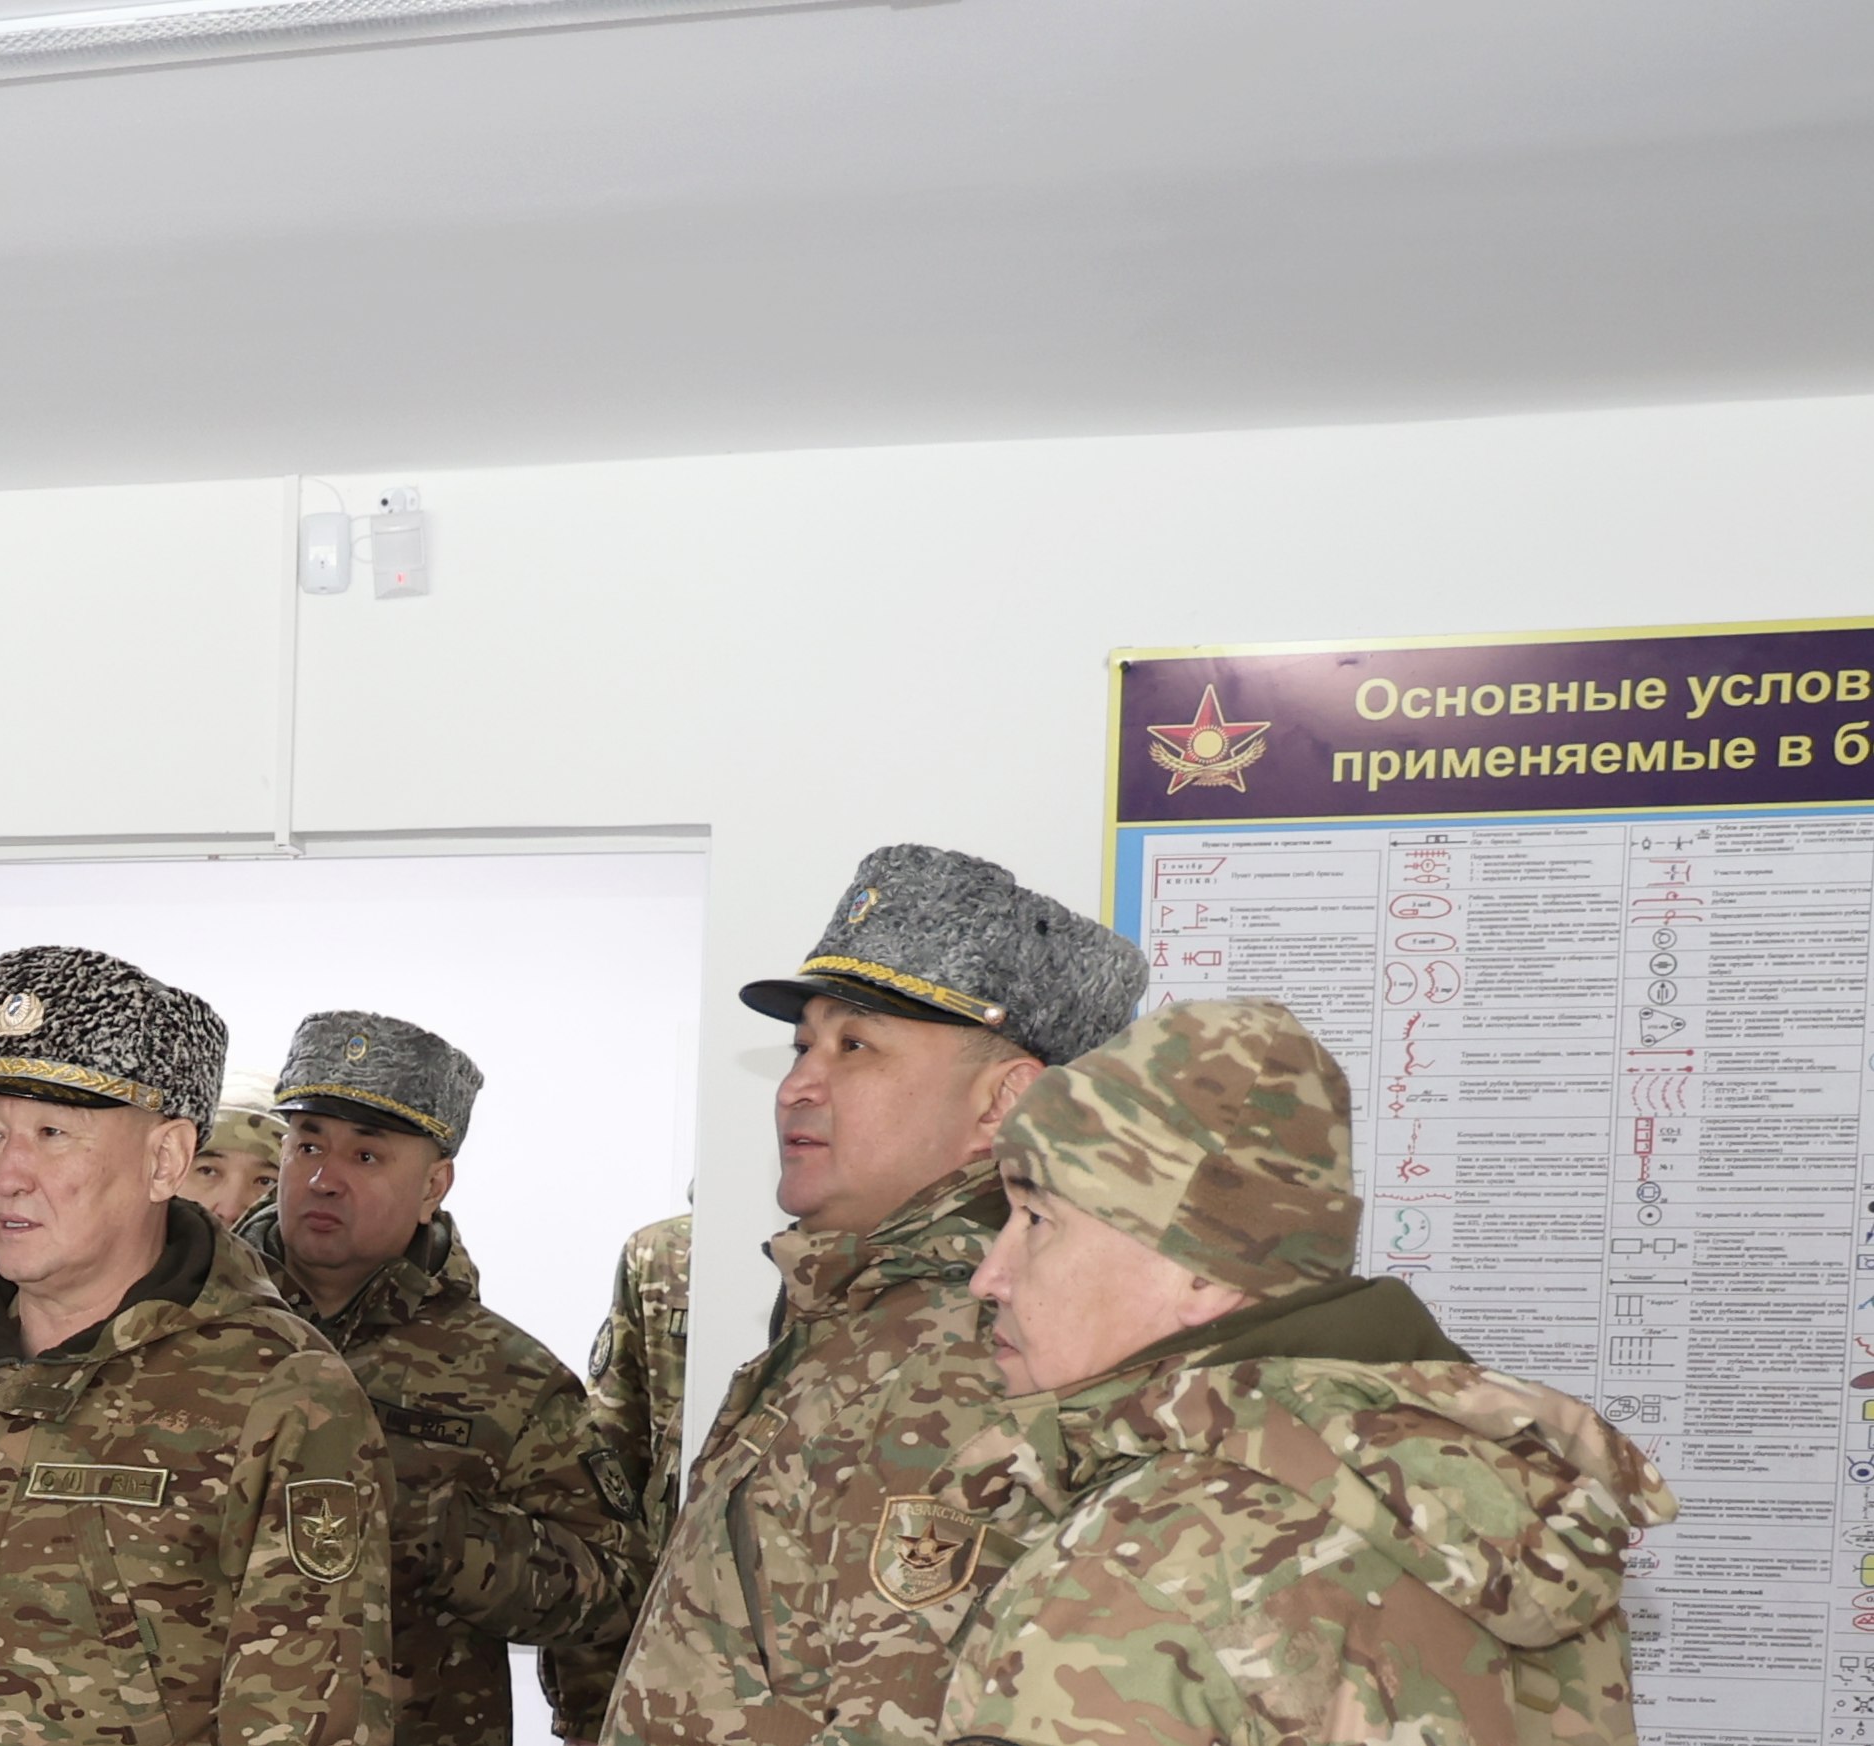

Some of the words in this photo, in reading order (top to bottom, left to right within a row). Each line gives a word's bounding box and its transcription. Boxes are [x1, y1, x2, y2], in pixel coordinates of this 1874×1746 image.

[1355, 676, 1668, 721] Основные
[1332, 735, 1757, 792] применяемые
[1777, 734, 1813, 768] в
